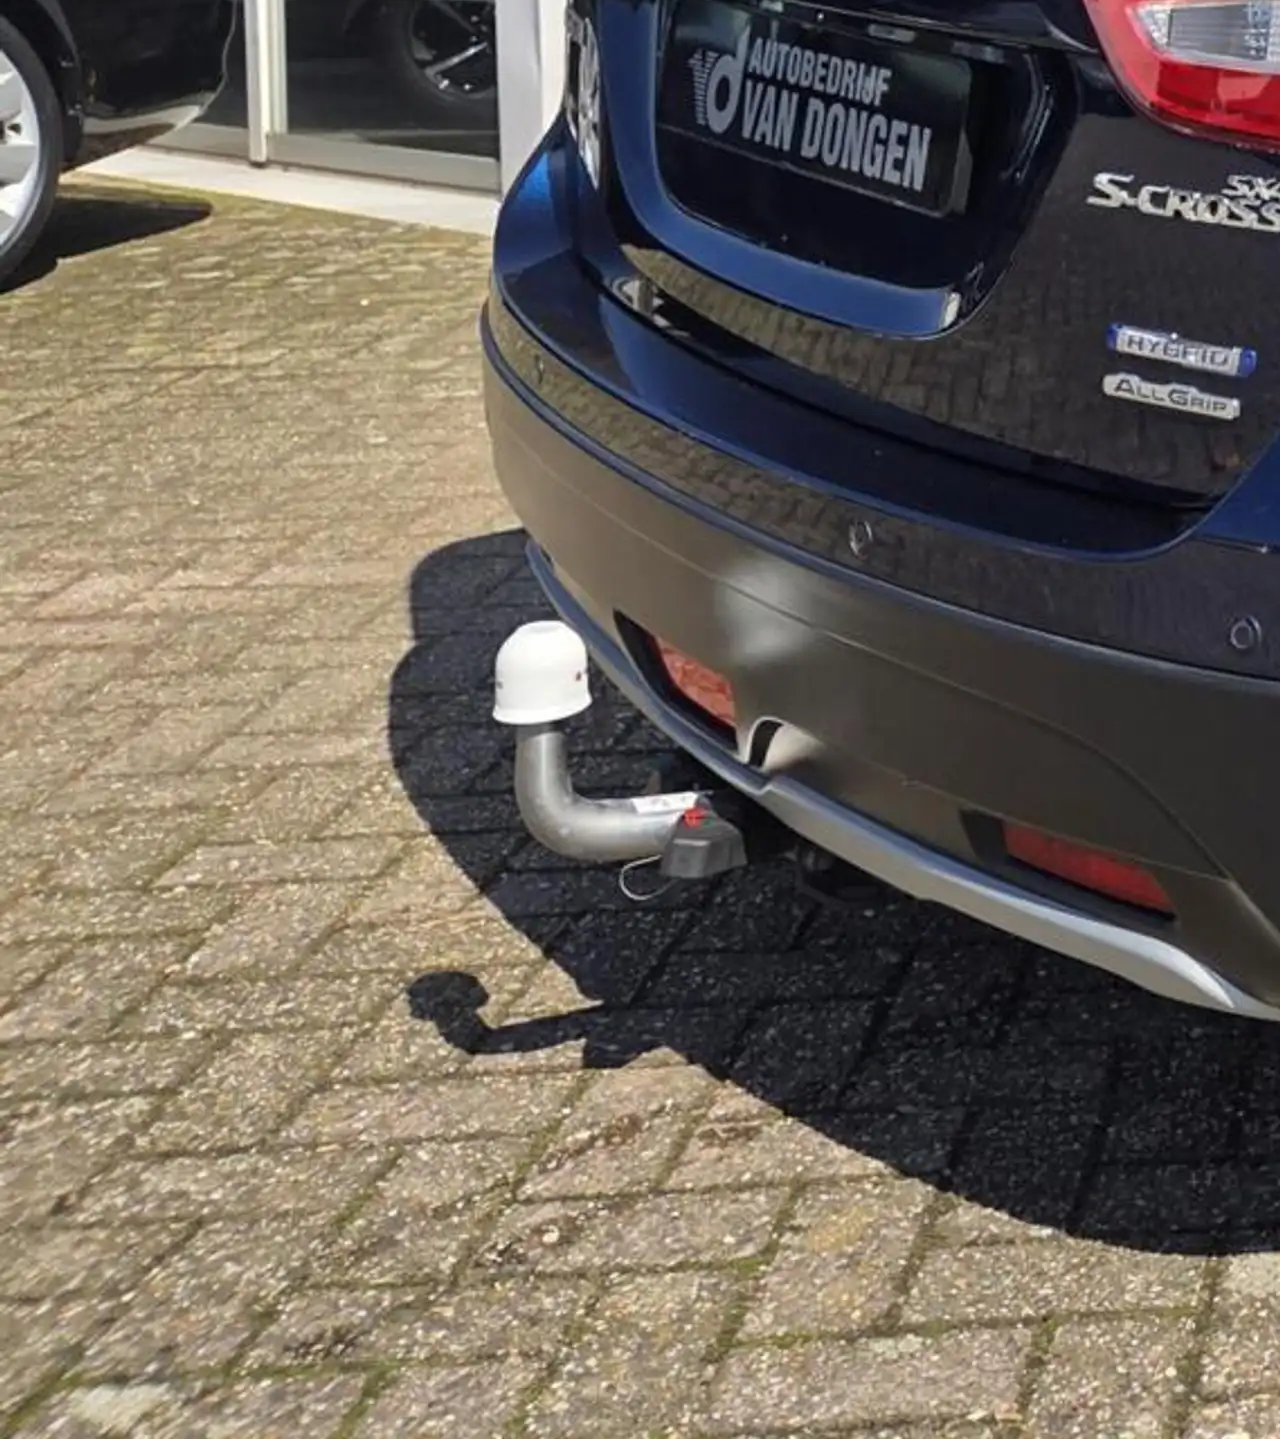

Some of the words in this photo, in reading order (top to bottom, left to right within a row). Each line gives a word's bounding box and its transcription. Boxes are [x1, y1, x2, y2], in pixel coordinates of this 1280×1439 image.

[749, 38, 893, 107] AUTOBEDRIJF
[742, 78, 798, 152] VAN
[800, 96, 932, 192] DONGEN
